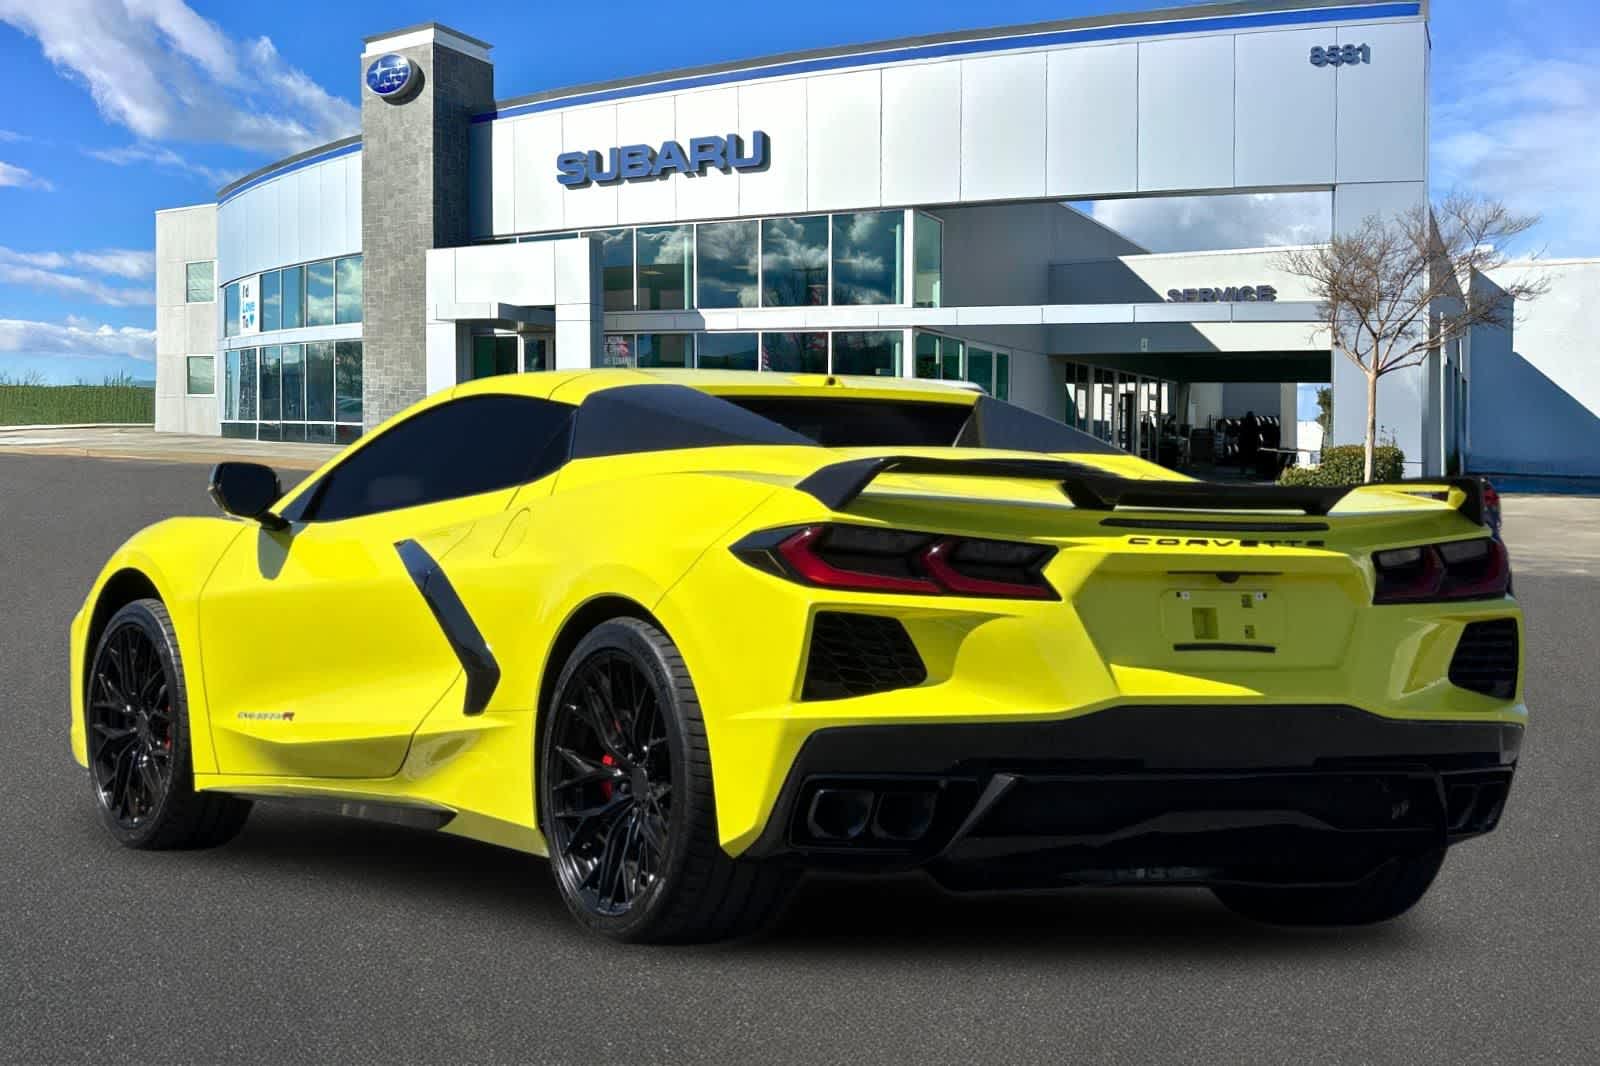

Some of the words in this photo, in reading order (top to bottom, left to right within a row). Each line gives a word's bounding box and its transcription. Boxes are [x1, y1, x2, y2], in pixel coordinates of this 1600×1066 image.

[556, 130, 770, 190] SUBARU
[1167, 285, 1277, 302] SERVICE
[1128, 537, 1325, 547] CORVETTE
